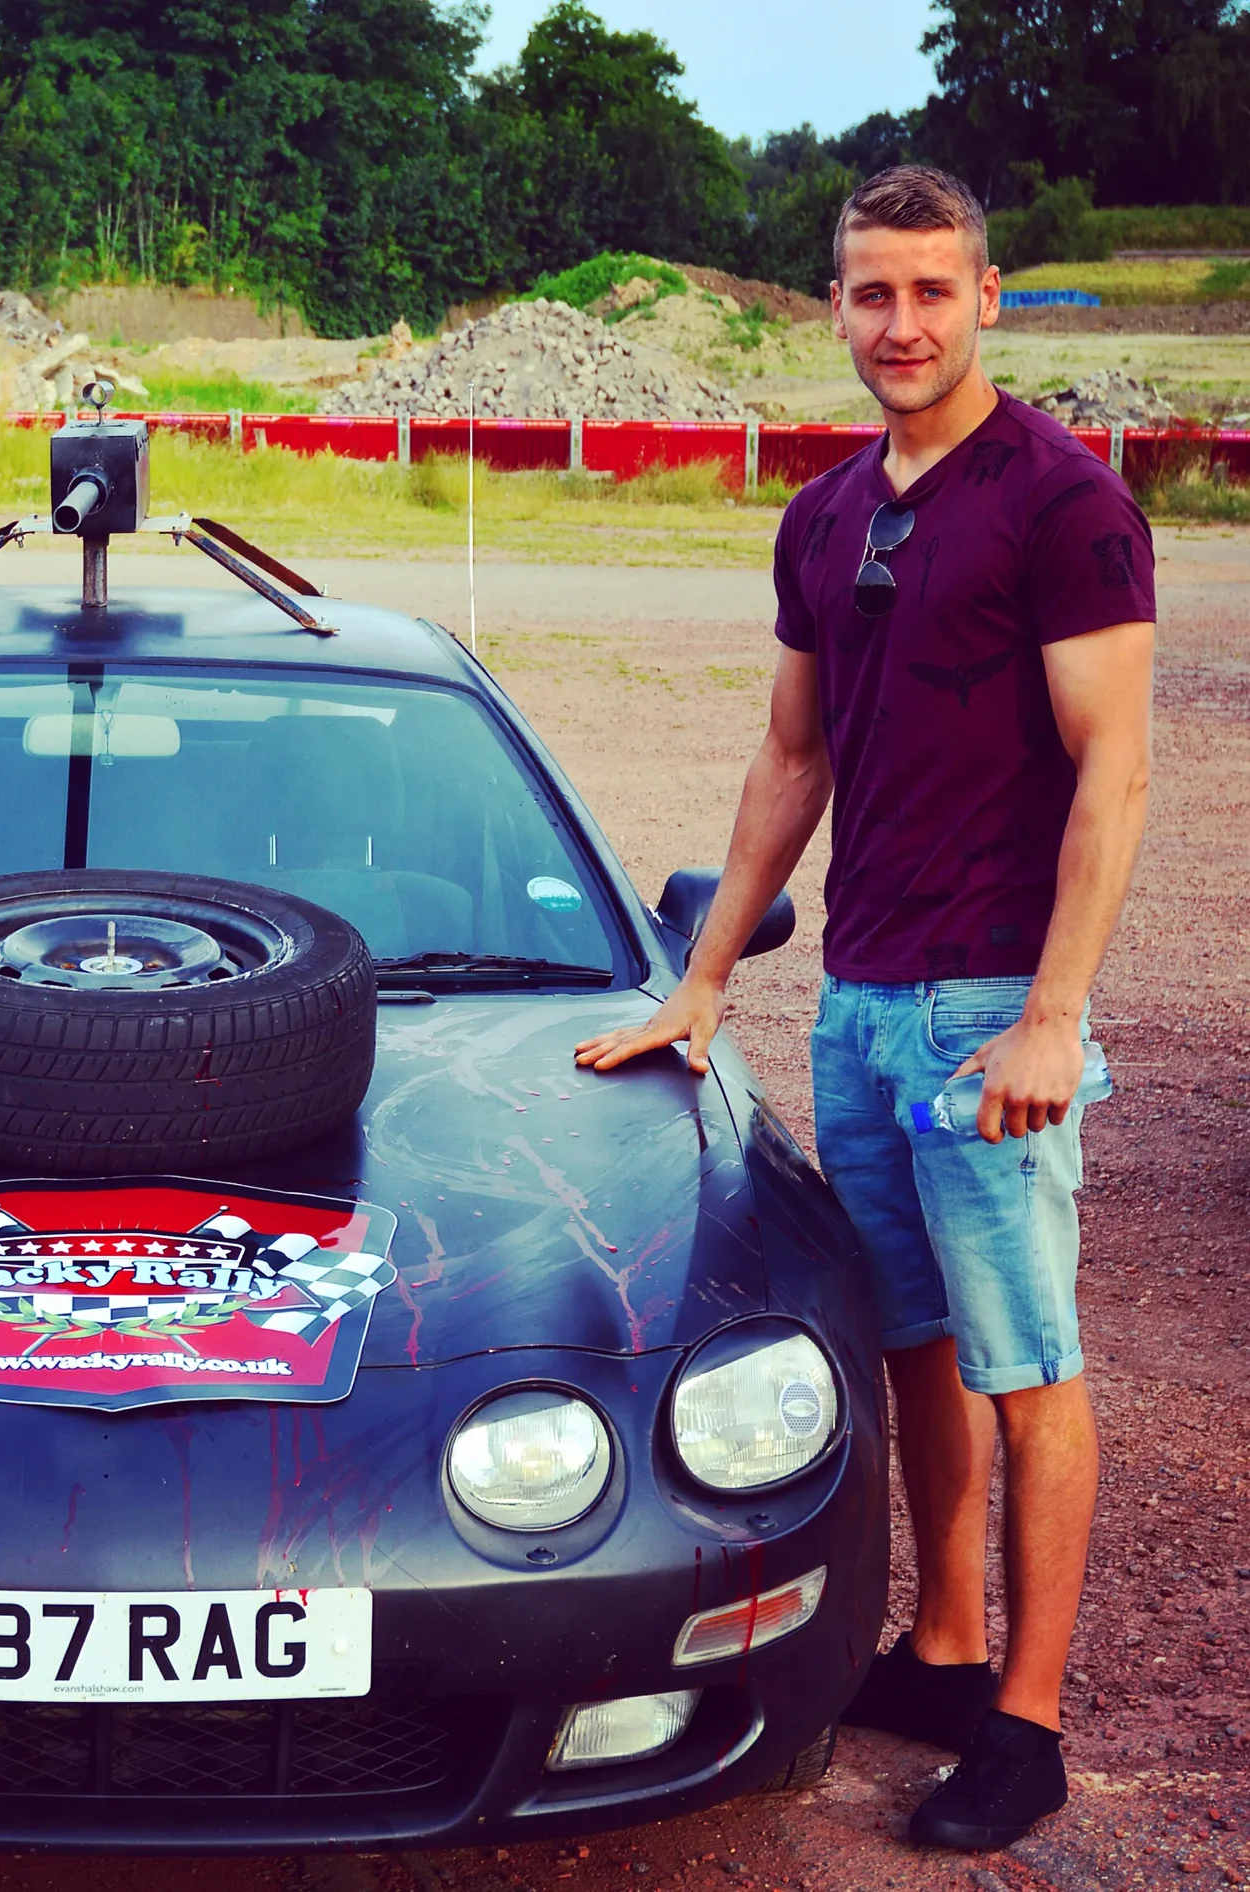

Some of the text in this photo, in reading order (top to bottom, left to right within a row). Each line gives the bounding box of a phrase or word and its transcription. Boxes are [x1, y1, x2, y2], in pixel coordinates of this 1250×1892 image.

[131, 1260, 291, 1301] Rally
[128, 1601, 308, 1681] RAG
[53, 1683, 145, 1694] evanshalshaw.com
